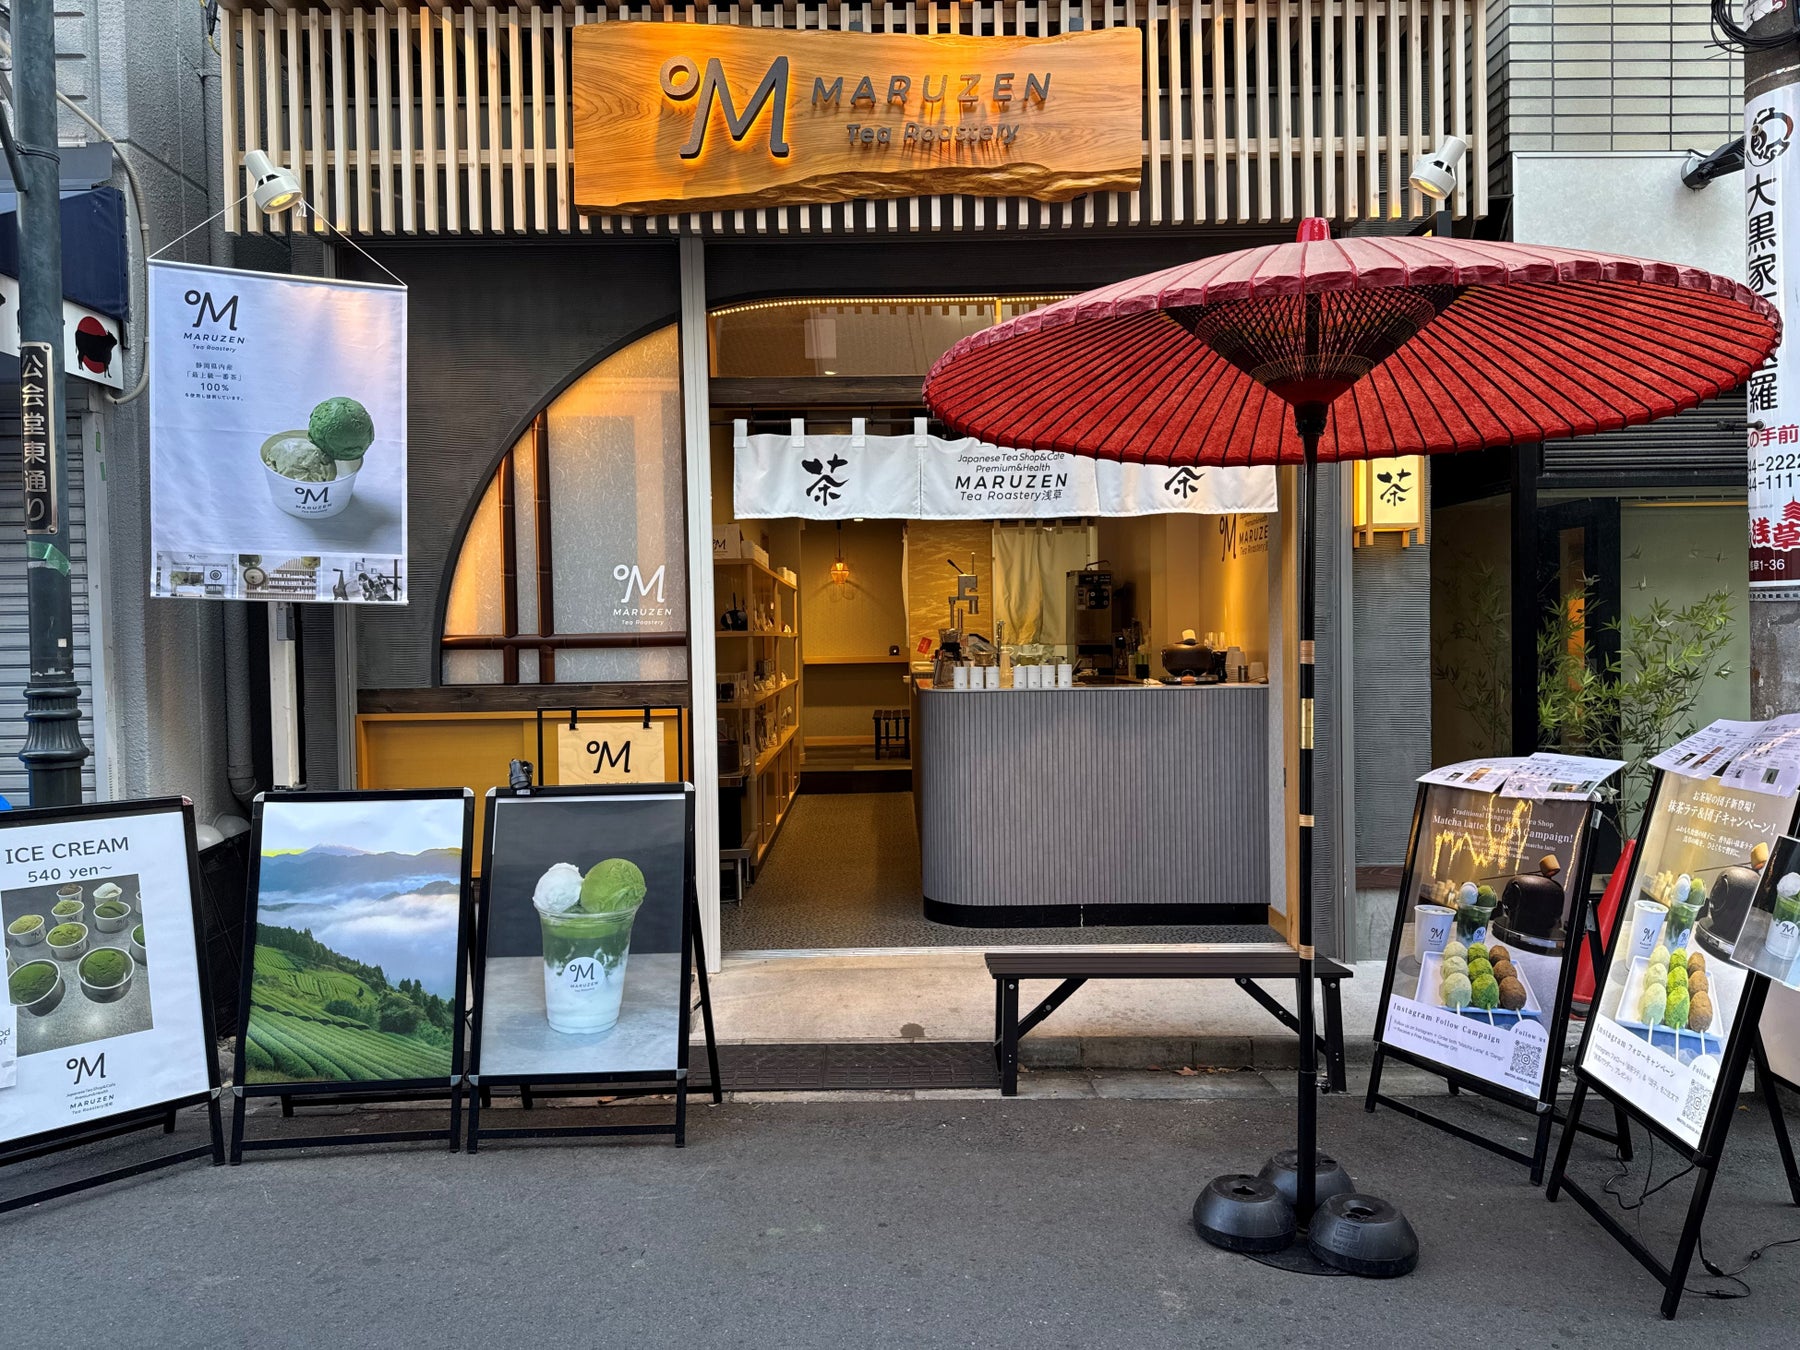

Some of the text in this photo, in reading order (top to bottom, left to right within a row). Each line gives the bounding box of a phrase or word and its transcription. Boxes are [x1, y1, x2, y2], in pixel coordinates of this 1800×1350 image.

[812, 72, 1051, 105] MARUZEN
[846, 122, 1020, 145] Tea Roastery
[183, 332, 245, 344] MARUZEN
[200, 382, 229, 391] 100%
[22, 354, 47, 522] 公会堂東通り
[958, 454, 1001, 464] Japanese
[1001, 453, 1018, 462] Tea
[976, 463, 1051, 473] Premium&Health
[801, 453, 850, 507] 茶
[955, 473, 1067, 490] MARUZEN
[1376, 469, 1413, 506] 茶
[960, 491, 982, 501] Tea
[613, 608, 672, 616] MARUZEN
[1432, 815, 1462, 827] Matcha
[1463, 819, 1484, 831] Latte
[1494, 823, 1521, 836] Dago
[1452, 808, 1484, 818] Traditional
[1538, 819, 1554, 829] Shop
[5, 837, 129, 864] ICE CREAM
[28, 868, 61, 883] 540
[1393, 1003, 1501, 1045] Instagram Follow Campaign
[1514, 1028, 1538, 1041] Follow
[1596, 1023, 1627, 1049] Instagram
[1692, 1064, 1711, 1079] Follow
[70, 1094, 114, 1110] MARUZEN
